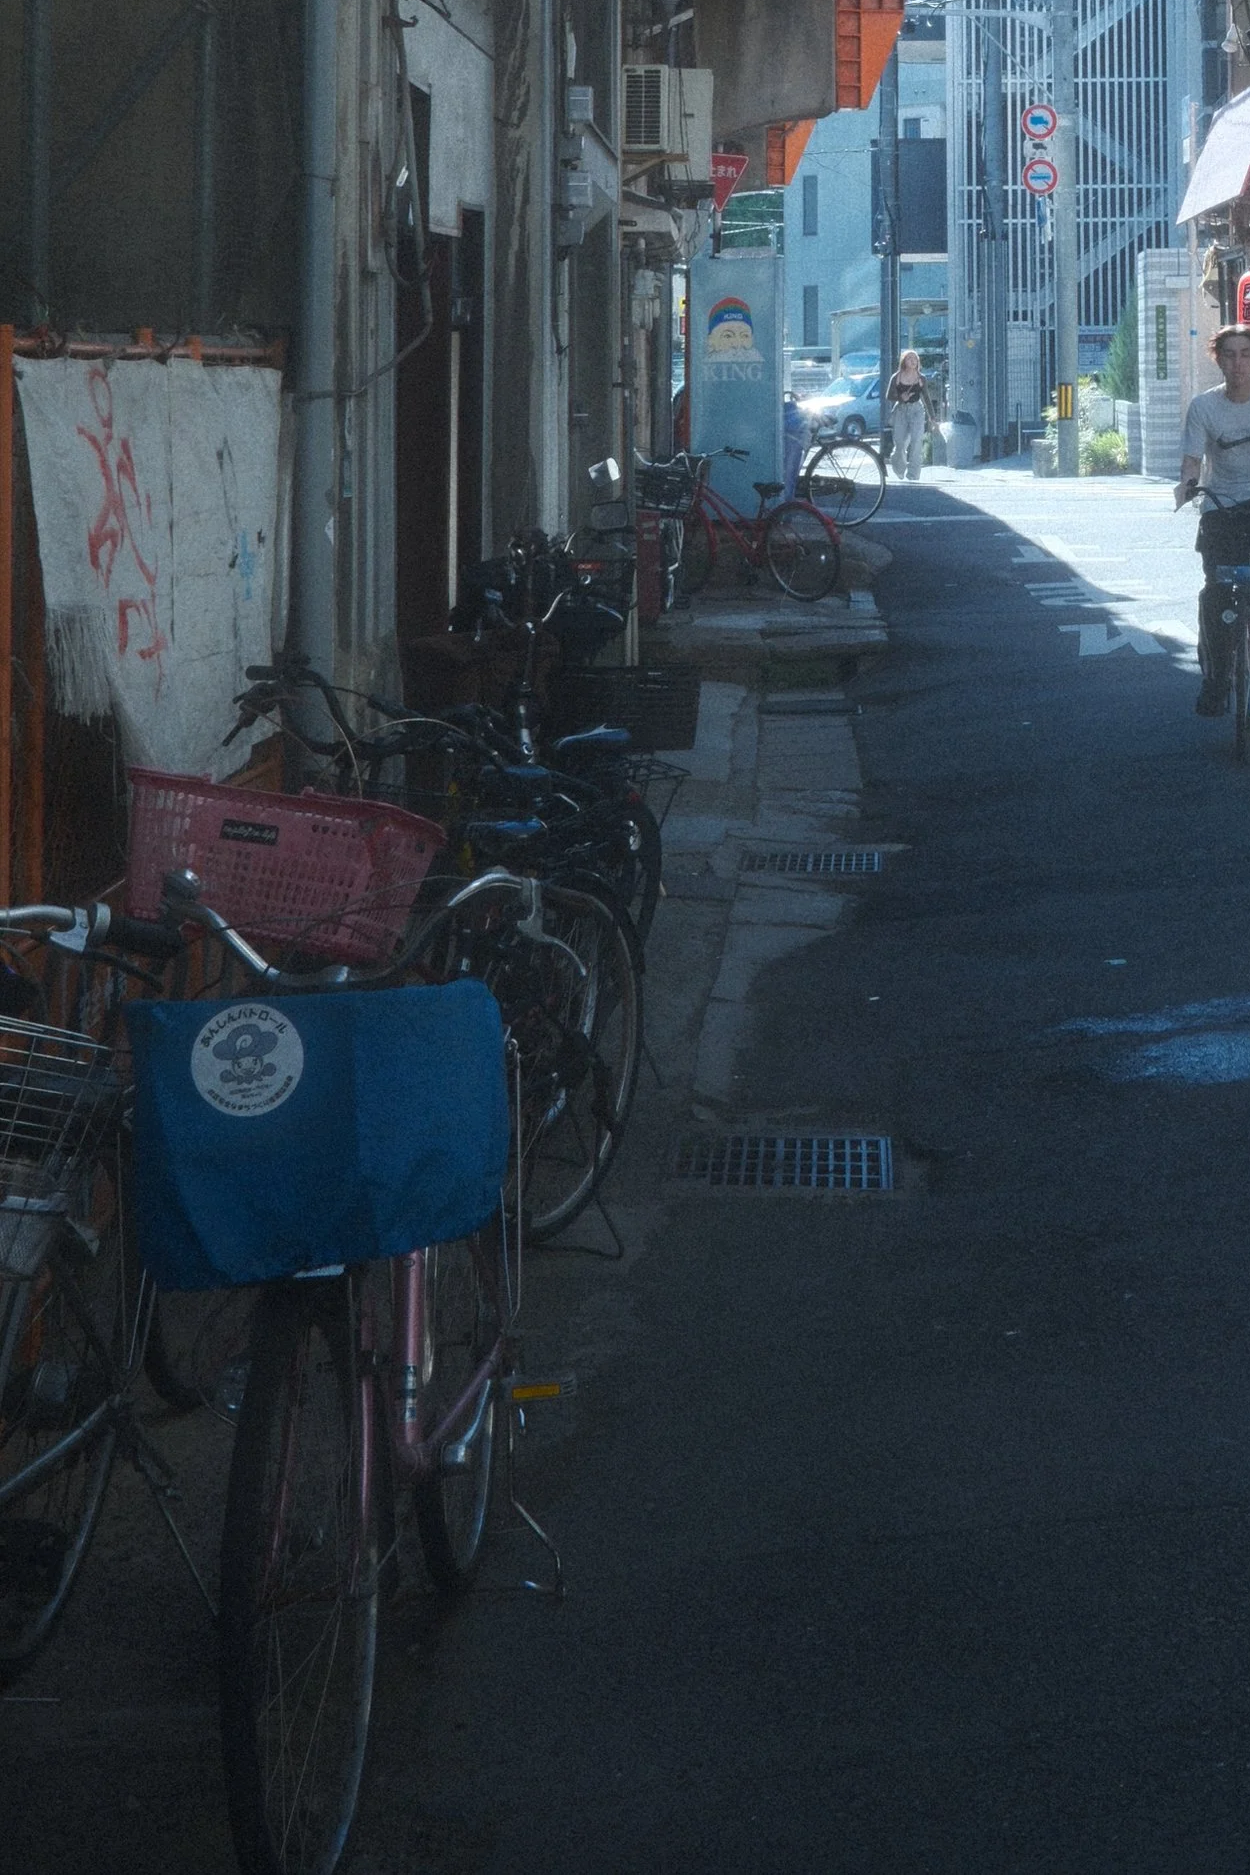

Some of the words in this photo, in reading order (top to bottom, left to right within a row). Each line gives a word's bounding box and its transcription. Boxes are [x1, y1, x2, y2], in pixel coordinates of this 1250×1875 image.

[702, 363, 762, 381] KING
[1012, 534, 1198, 656] 止まれ
